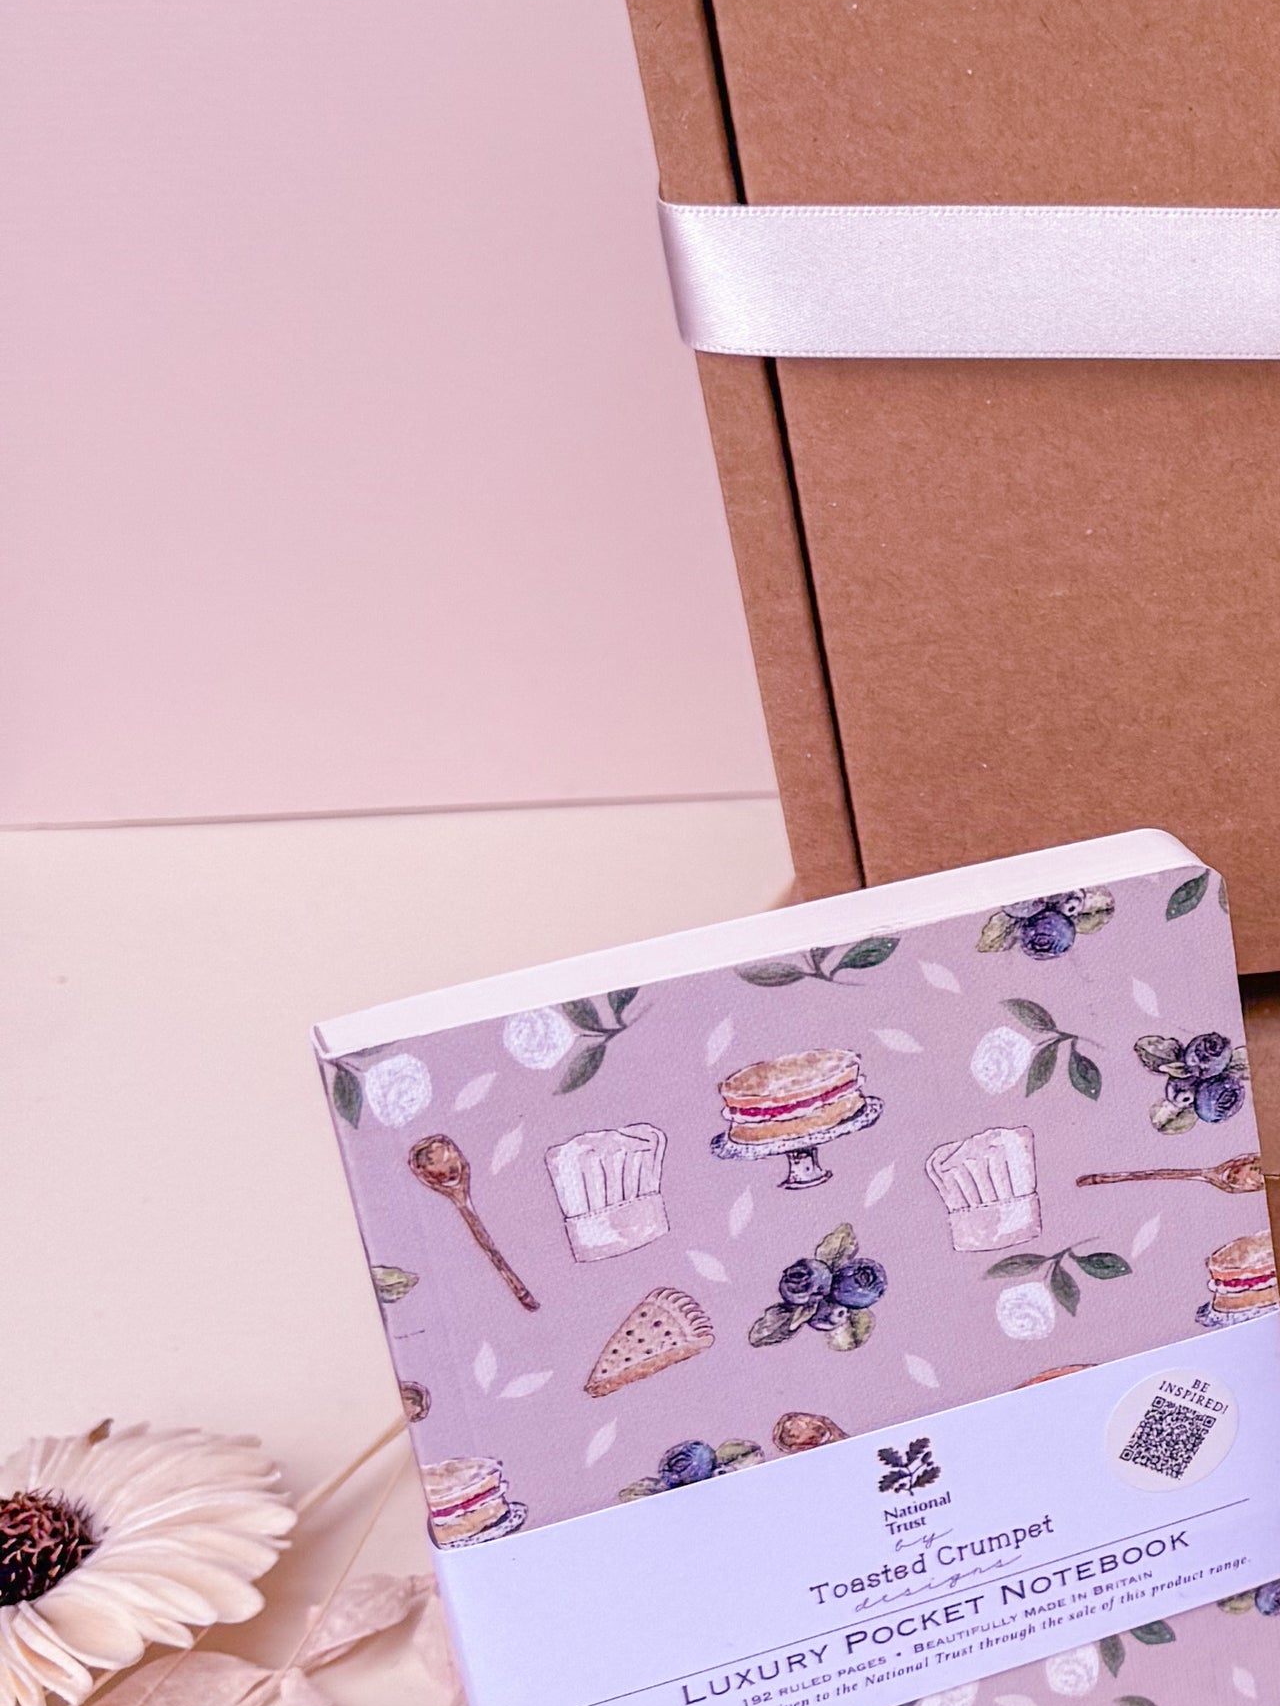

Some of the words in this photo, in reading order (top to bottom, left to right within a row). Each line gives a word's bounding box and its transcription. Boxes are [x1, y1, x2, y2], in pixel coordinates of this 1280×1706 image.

[1159, 1380, 1229, 1415] INSPIRED!
[1191, 1379, 1211, 1393] BE
[884, 1491, 952, 1521] National
[885, 1516, 927, 1536] Trust
[809, 1553, 927, 1605] Toasted
[937, 1515, 1055, 1566] Crumpet
[895, 1529, 953, 1552] by
[854, 1554, 1022, 1613] designs
[682, 1644, 828, 1706] LUXURY
[845, 1595, 985, 1654] POCKET
[1000, 1531, 1190, 1606] NOTEBOOK
[779, 1673, 832, 1697] RULED
[837, 1656, 888, 1678] PAGES
[914, 1613, 1018, 1654] BEAUTIFULLY
[1024, 1597, 1067, 1619] MADE
[1072, 1591, 1088, 1603] IN
[1093, 1570, 1153, 1596] BRITAIN
[816, 1690, 830, 1703] to
[836, 1682, 859, 1697] the
[865, 1657, 929, 1687] National
[935, 1644, 974, 1665] Trust
[979, 1625, 1036, 1652] through
[1042, 1614, 1064, 1631] the
[1068, 1604, 1098, 1623] sale
[1102, 1596, 1117, 1613] of
[1120, 1589, 1146, 1605] this
[1151, 1570, 1205, 1598] product
[1209, 1554, 1252, 1579] range.
